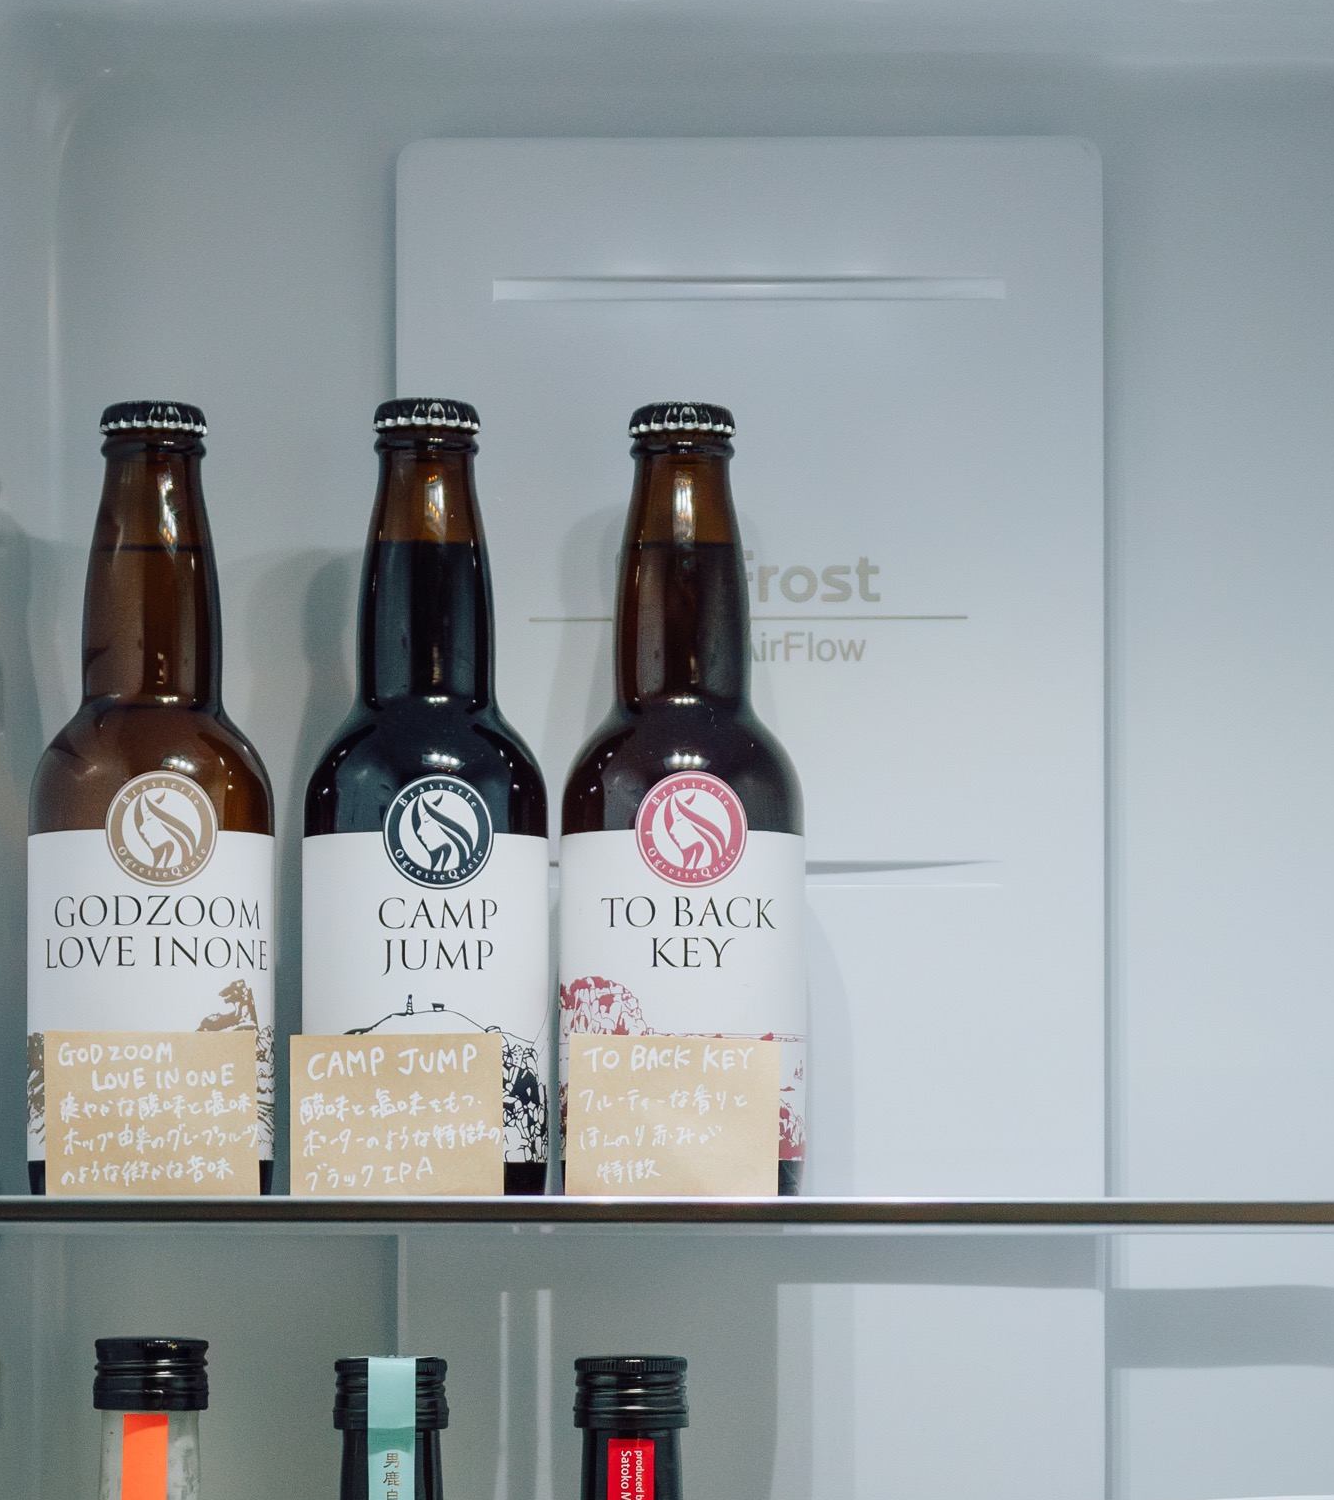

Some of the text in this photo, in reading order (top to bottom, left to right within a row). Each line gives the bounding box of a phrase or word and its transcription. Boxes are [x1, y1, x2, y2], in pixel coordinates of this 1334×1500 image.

[54, 894, 261, 930] GODZOOM
[377, 896, 499, 930] CAMP
[600, 895, 778, 930] TO BACK
[45, 936, 136, 969] LOVE
[381, 938, 495, 977] JUMP
[650, 936, 737, 969] KEY
[307, 1043, 478, 1081] CAMP JUMP
[582, 1044, 754, 1073] TO BACK KEY
[91, 1067, 147, 1092] LOVE
[596, 1157, 661, 1184] 特徴
[620, 1450, 632, 1489] Satoko
[634, 1450, 644, 1494] produced
